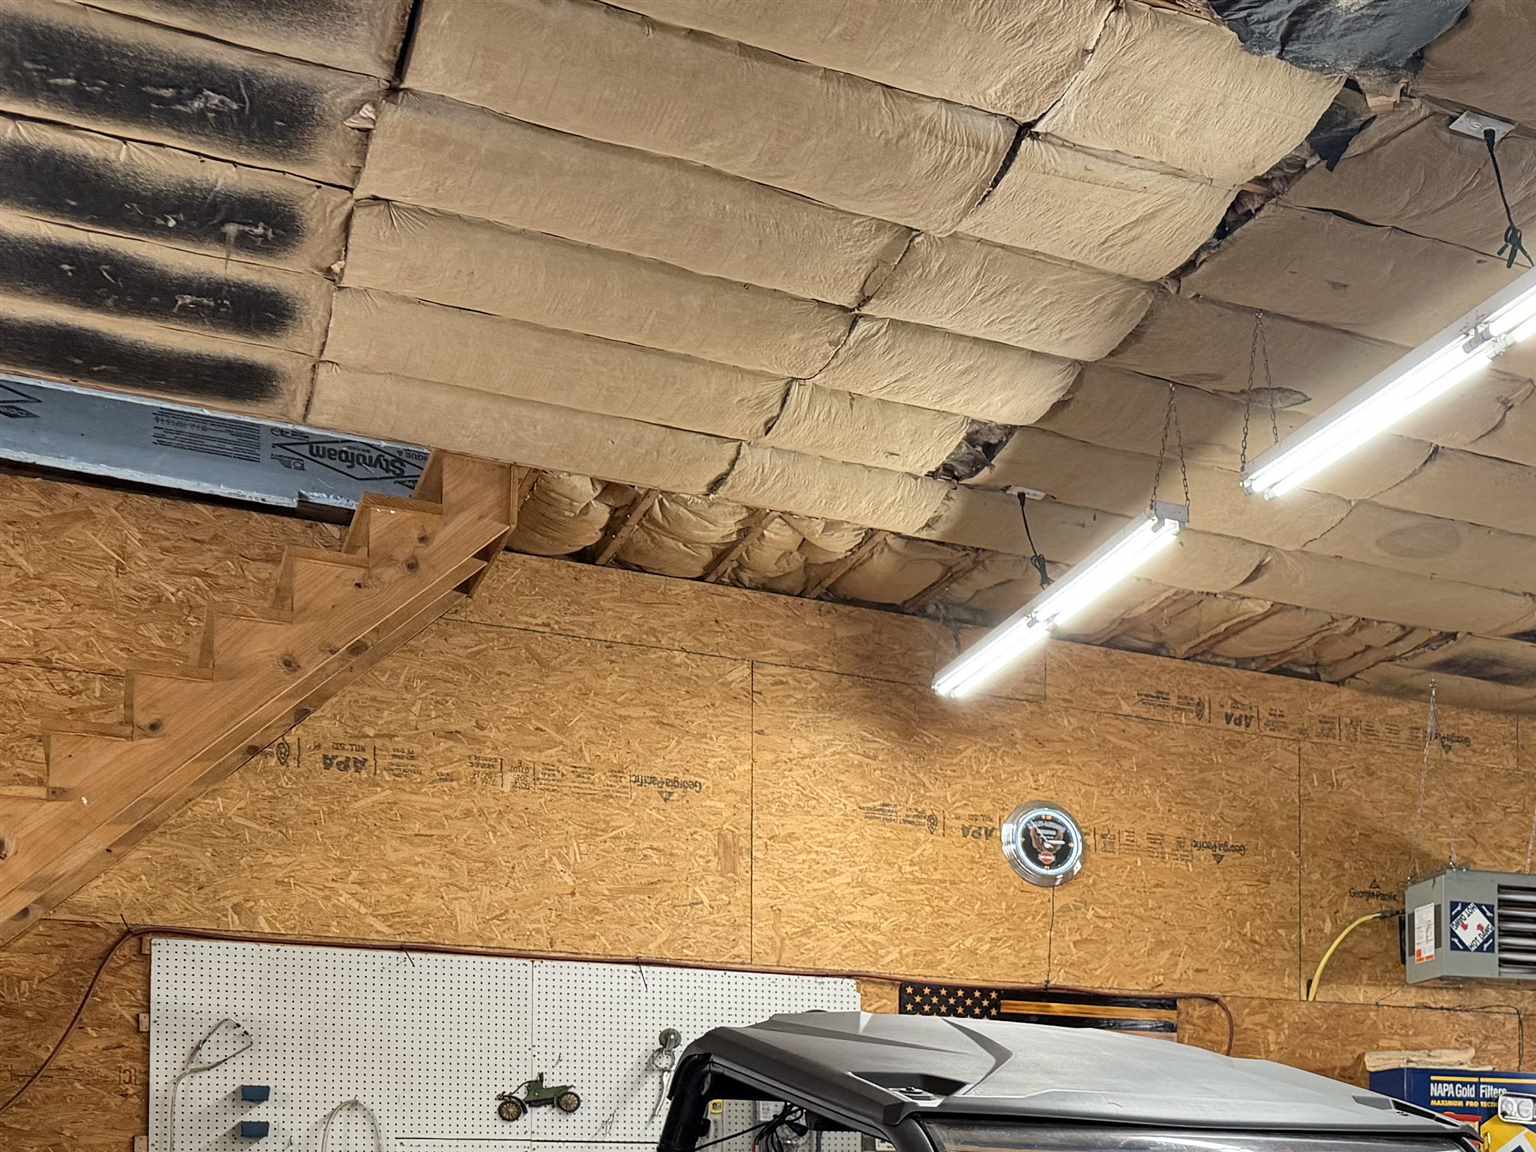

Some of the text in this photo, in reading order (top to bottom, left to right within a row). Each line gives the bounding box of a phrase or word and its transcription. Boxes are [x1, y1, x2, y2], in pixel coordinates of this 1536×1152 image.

[308, 443, 407, 477] Styrofoam
[1430, 1082, 1455, 1097] NAPA
[1455, 1083, 1475, 1098] Gold
